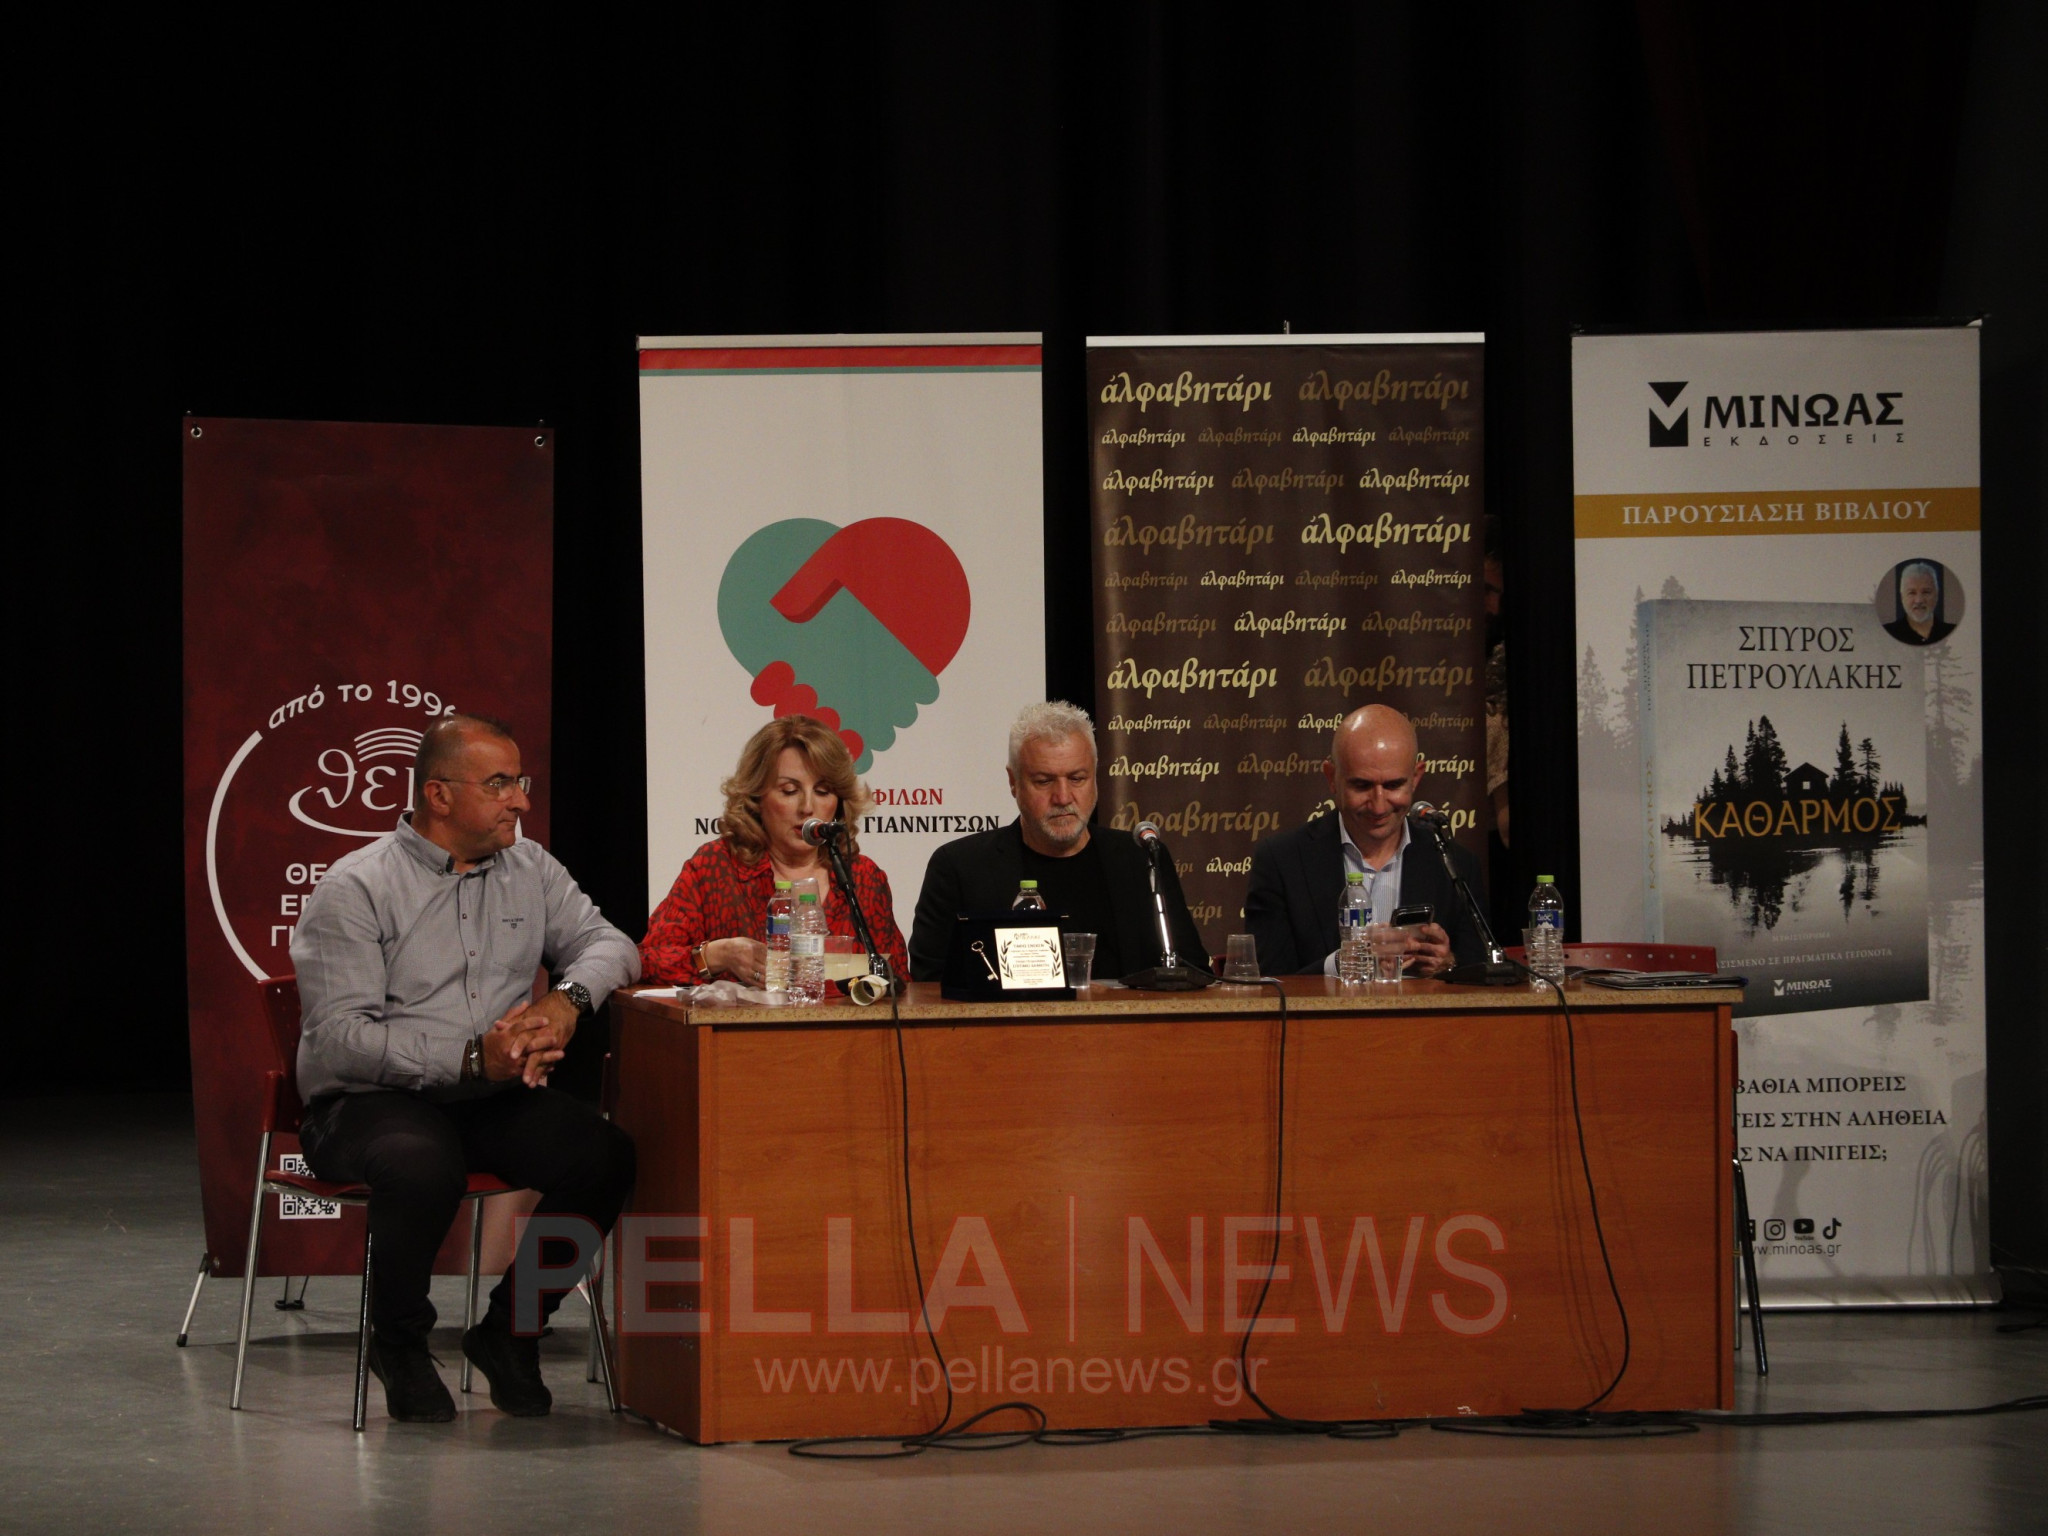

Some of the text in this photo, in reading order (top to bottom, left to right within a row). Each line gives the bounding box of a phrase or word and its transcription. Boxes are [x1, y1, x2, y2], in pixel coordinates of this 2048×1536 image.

[1704, 392, 1904, 429] ΜΙΝΩΑΣ
[1704, 433, 1904, 448] ΕΚΔΟΣΕΙΣ
[1622, 500, 1932, 525] ΠΑΡΟΥΣΙΑΣΗ ΒΙΒΛΙΟΥ
[1738, 626, 1855, 652] ΣΠΥΡΟΣ
[1687, 662, 1903, 690] ΠΕΤΡΟΥΛΑΚΗΣ
[268, 684, 326, 730] από
[337, 683, 373, 703] το
[871, 788, 943, 806] ΦΙΛΩΝ
[864, 815, 1000, 833] ΓΙΑΝΝΙΤΣΩΝ
[1693, 797, 1901, 839] ΚΑΘΑΡΜΟΣ
[1807, 1076, 1906, 1093] ΜΠΟΡΕΙΣ
[1781, 1111, 1841, 1128] ΣΤΗΝ
[1847, 1109, 1947, 1126] ΑΛΗΘΕΙΑ
[1758, 1146, 1789, 1162] ΝΑ
[1794, 1144, 1888, 1162] ΠΝΙΓΕΙΣ;
